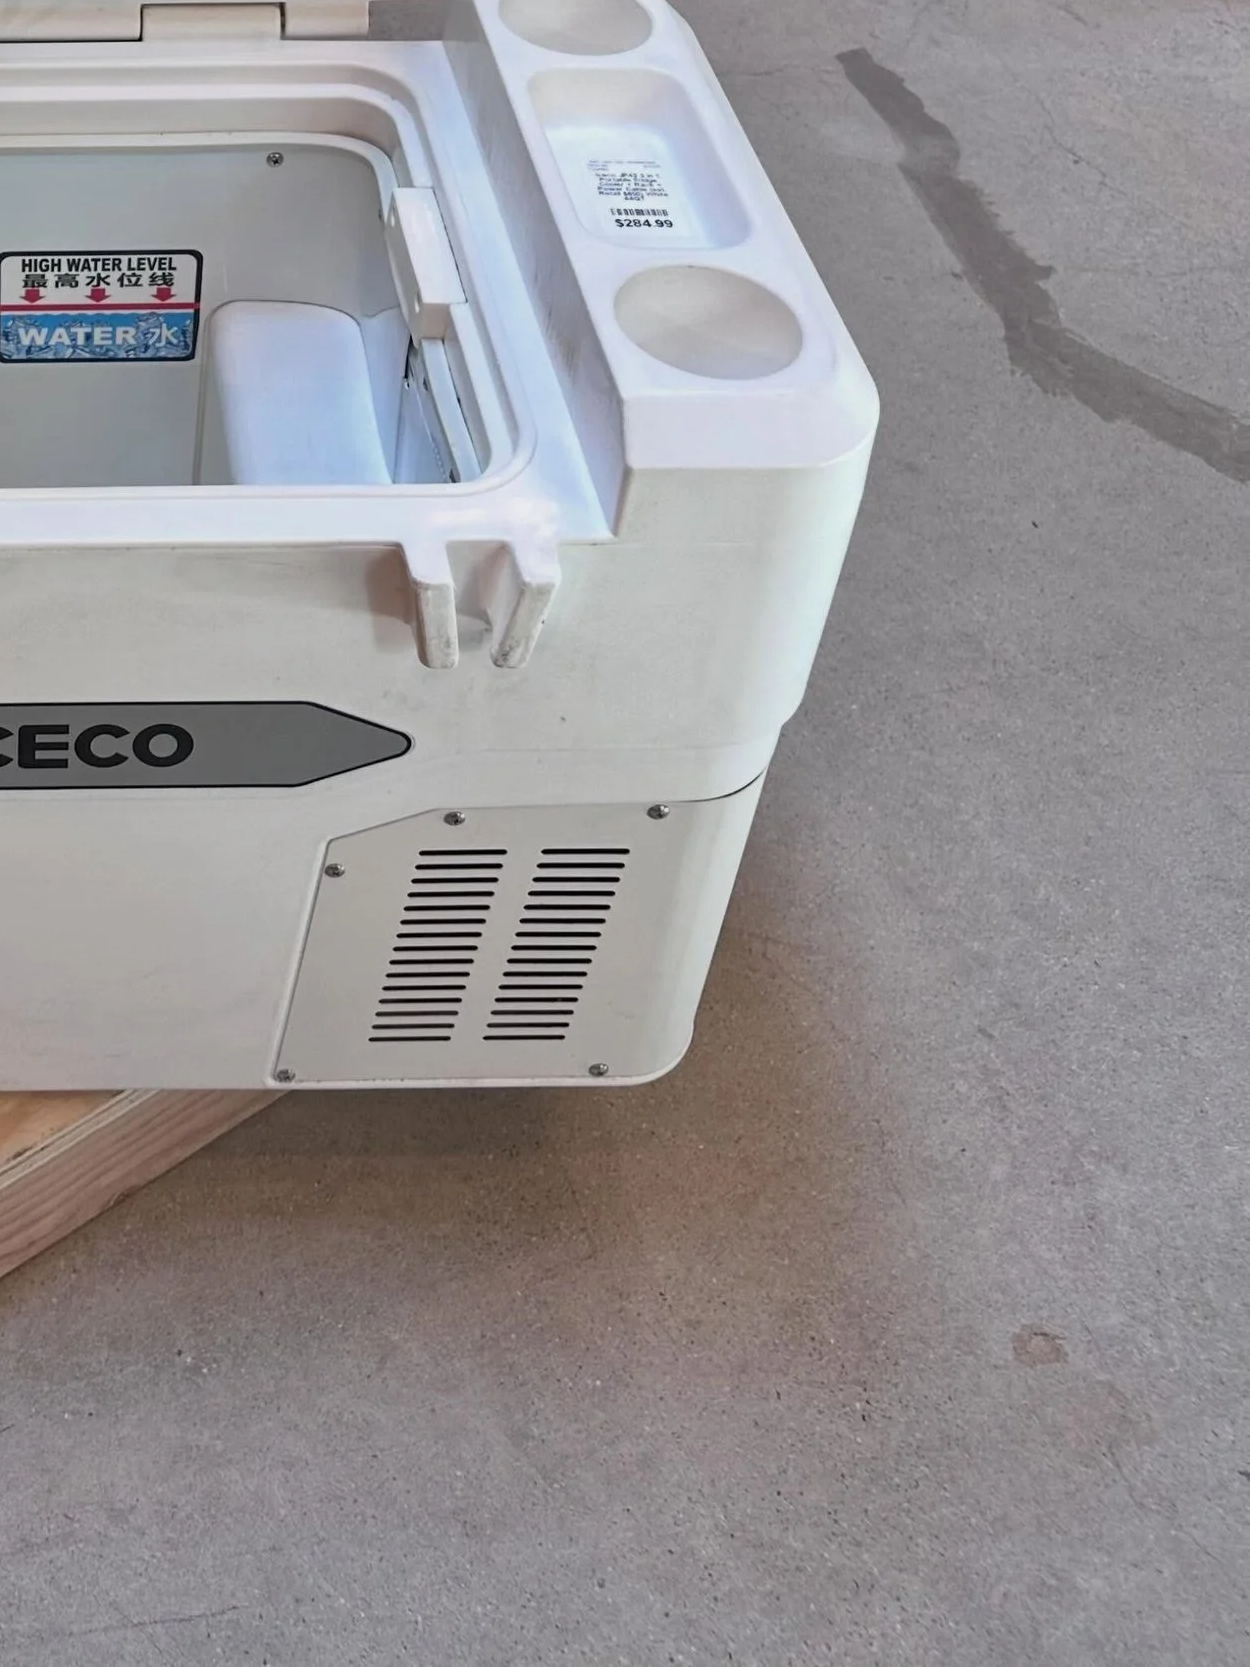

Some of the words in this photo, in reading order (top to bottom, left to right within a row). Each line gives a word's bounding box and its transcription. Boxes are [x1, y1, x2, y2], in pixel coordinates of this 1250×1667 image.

[615, 218, 673, 228] $284.99
[21, 258, 61, 273] HIGH
[66, 257, 122, 272] WATER
[127, 257, 177, 272] LEVEL
[22, 273, 175, 289] 最高水位线
[18, 326, 137, 346] WATER
[148, 323, 178, 347] 水
